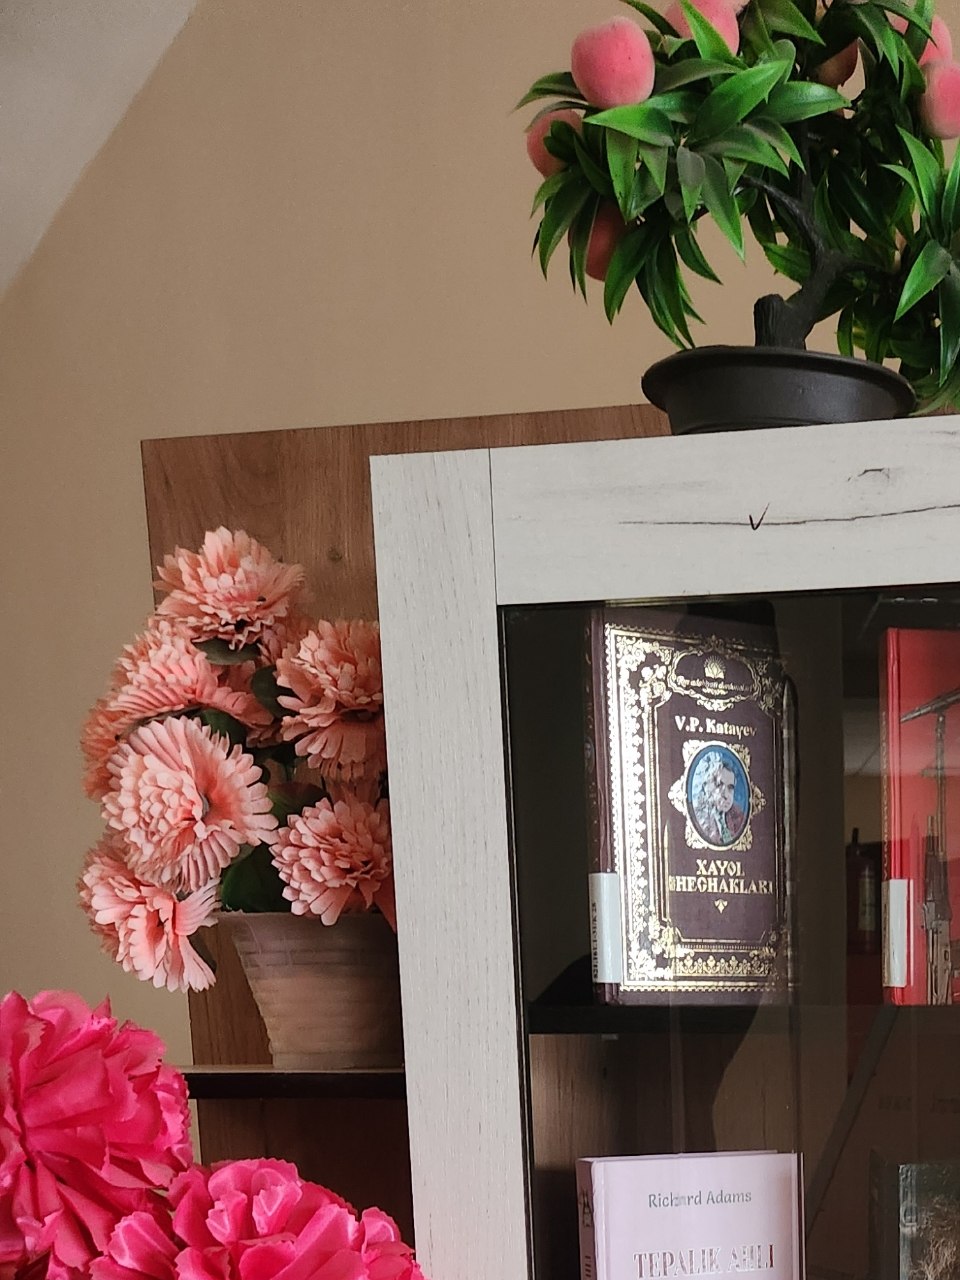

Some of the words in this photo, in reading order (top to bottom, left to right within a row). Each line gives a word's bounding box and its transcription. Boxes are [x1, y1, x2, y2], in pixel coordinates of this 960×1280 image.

[675, 715, 704, 732] V.P.
[706, 718, 757, 740] Katayev
[696, 859, 745, 877] XAYOL
[706, 1189, 752, 1205] Adams
[633, 1247, 721, 1279] TEPALIK
[728, 1243, 774, 1272] AHLI
